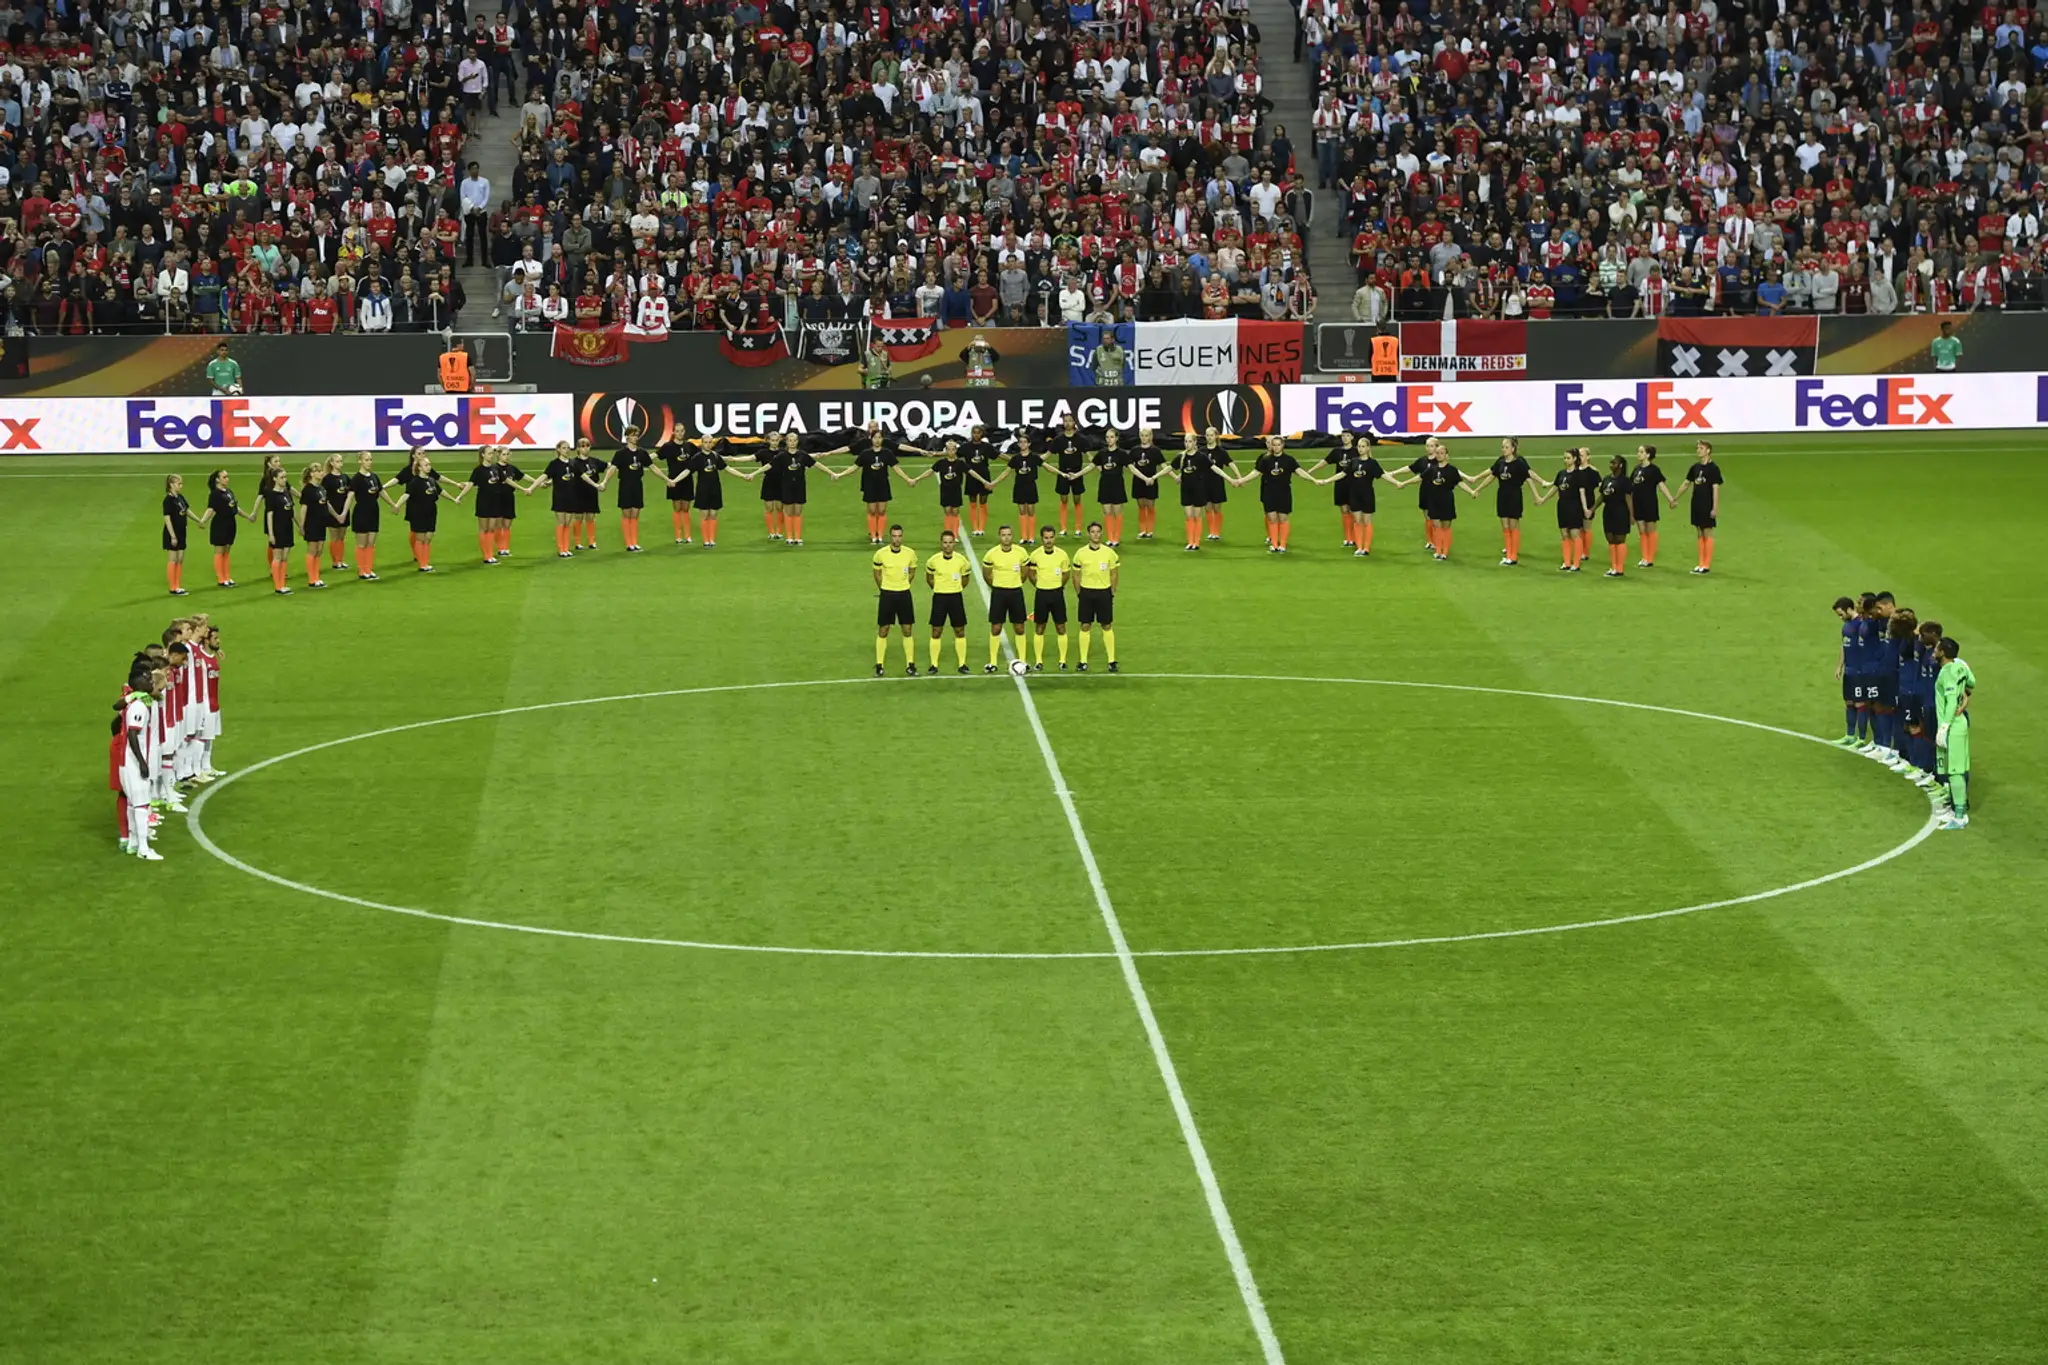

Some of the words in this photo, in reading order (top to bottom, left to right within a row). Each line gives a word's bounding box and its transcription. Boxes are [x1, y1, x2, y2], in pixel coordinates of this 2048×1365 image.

[1069, 340, 1300, 371] SREGUEMINES
[1412, 356, 1477, 369] DENMARK
[1481, 356, 1514, 369] REDS
[126, 399, 292, 449] FedEx
[374, 397, 537, 447] FedEx
[694, 402, 808, 435] UEFA
[819, 400, 985, 434] EUROPA
[997, 398, 1161, 431] LEAGUE
[1315, 385, 1473, 434] FedEx
[1555, 381, 1713, 430] FedEx
[1795, 377, 1954, 427] FedEx
